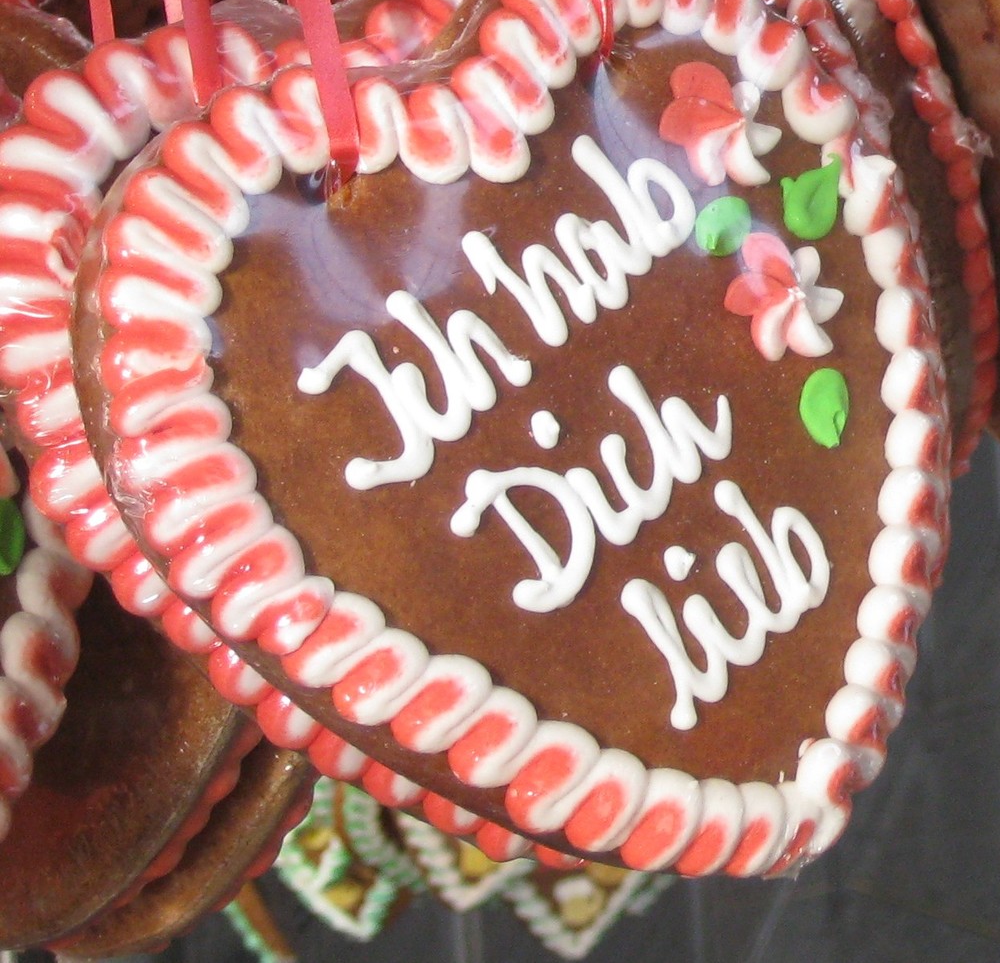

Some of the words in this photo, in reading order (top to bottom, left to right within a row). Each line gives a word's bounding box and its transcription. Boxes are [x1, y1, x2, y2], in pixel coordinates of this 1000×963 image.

[297, 290, 532, 490] Ich
[462, 134, 697, 347] hab
[450, 365, 732, 613] Dich
[620, 479, 830, 730] lieb
